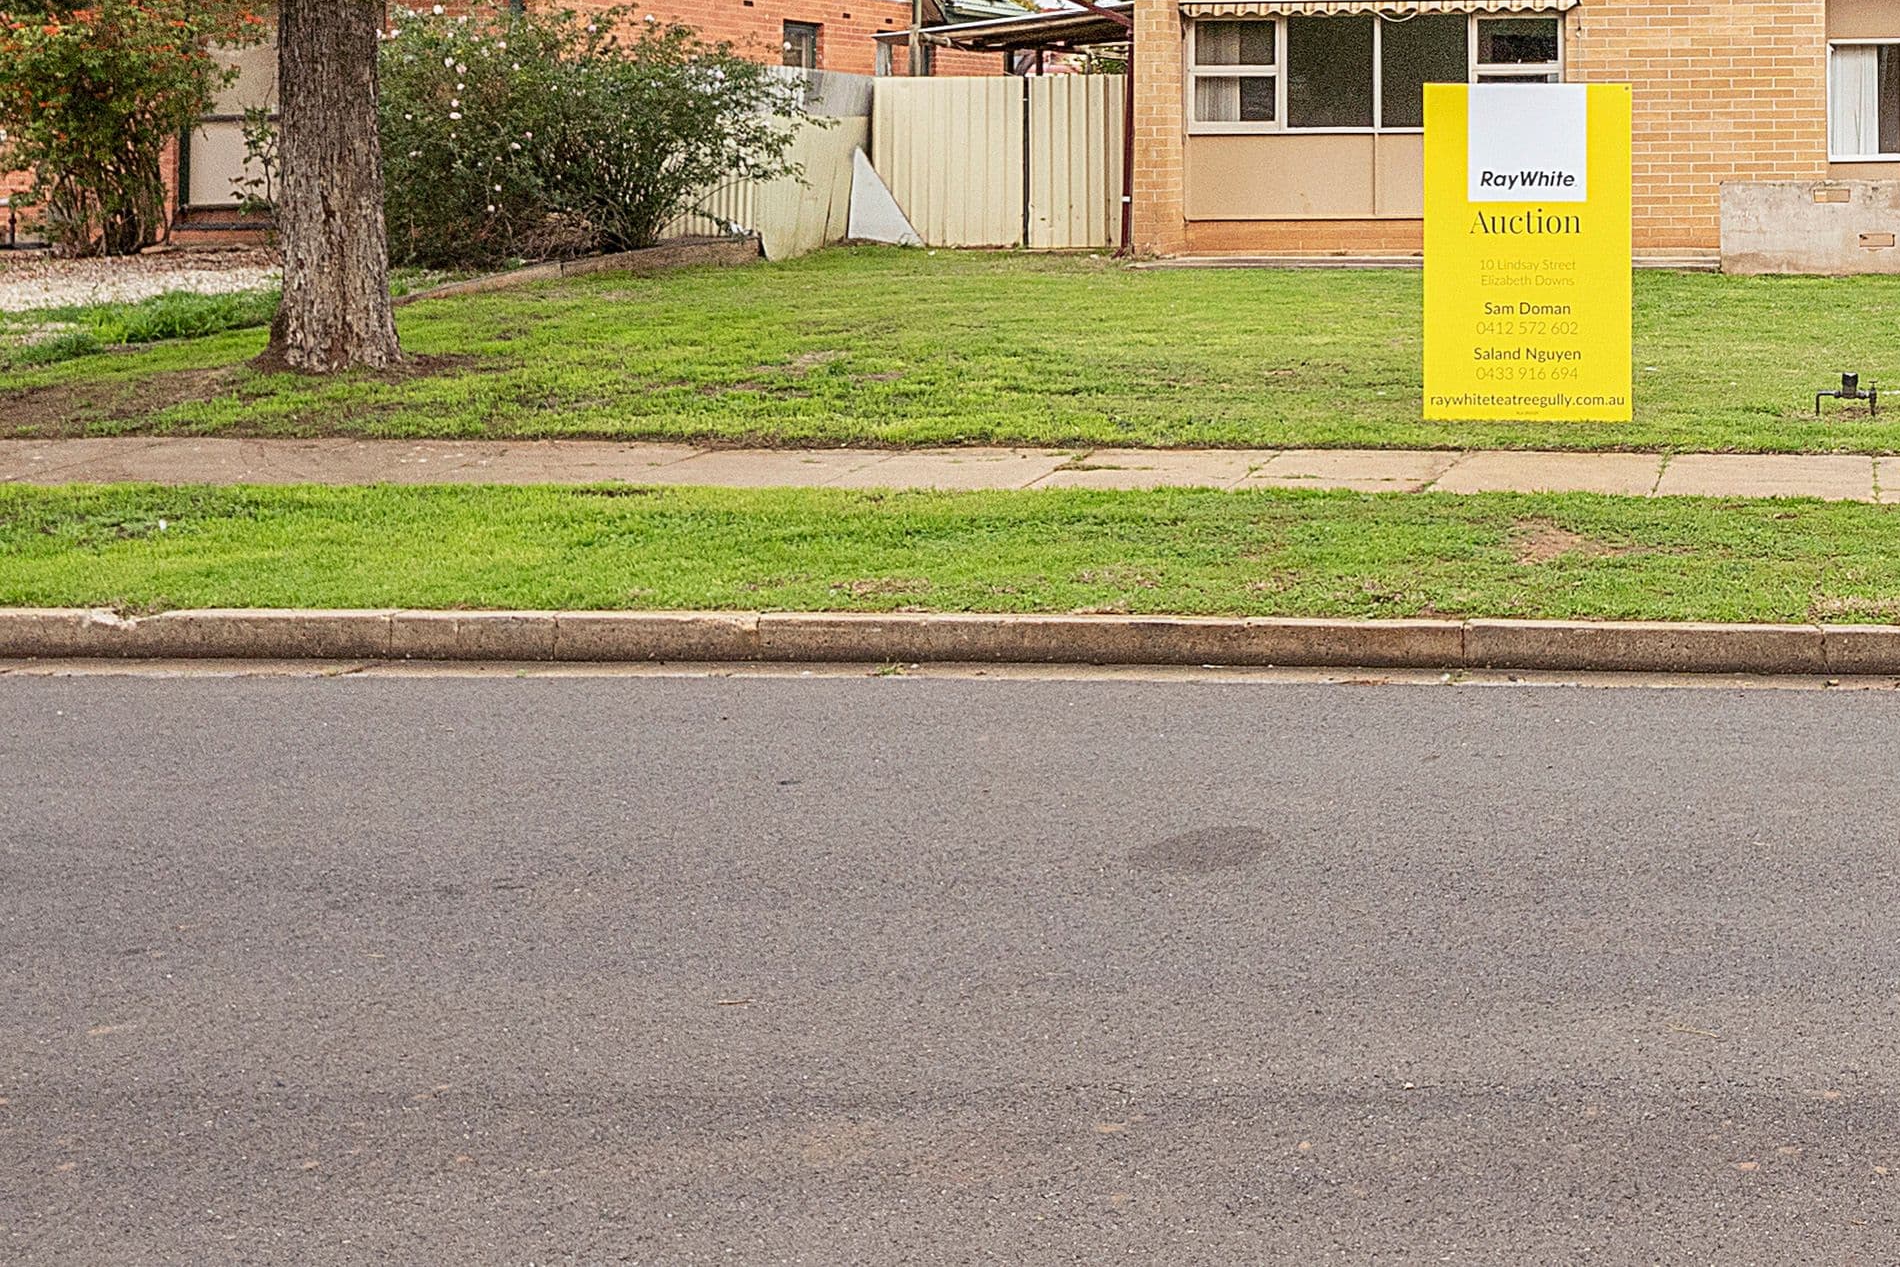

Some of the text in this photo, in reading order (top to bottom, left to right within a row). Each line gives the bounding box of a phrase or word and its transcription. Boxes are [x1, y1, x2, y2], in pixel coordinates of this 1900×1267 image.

[1480, 170, 1575, 191] RayWhite
[1469, 208, 1581, 235] Auction
[1480, 259, 1576, 272] 10 Lindsay Street
[1481, 275, 1575, 286] Elizabeth Downs
[1484, 302, 1571, 315] Sam Doman
[1475, 321, 1579, 335] 0412 572 602
[1473, 347, 1581, 363] Saland Nguyen
[1475, 367, 1578, 380] 0433 916 694
[1430, 393, 1625, 408] raywhiteteatreegully.com.au
